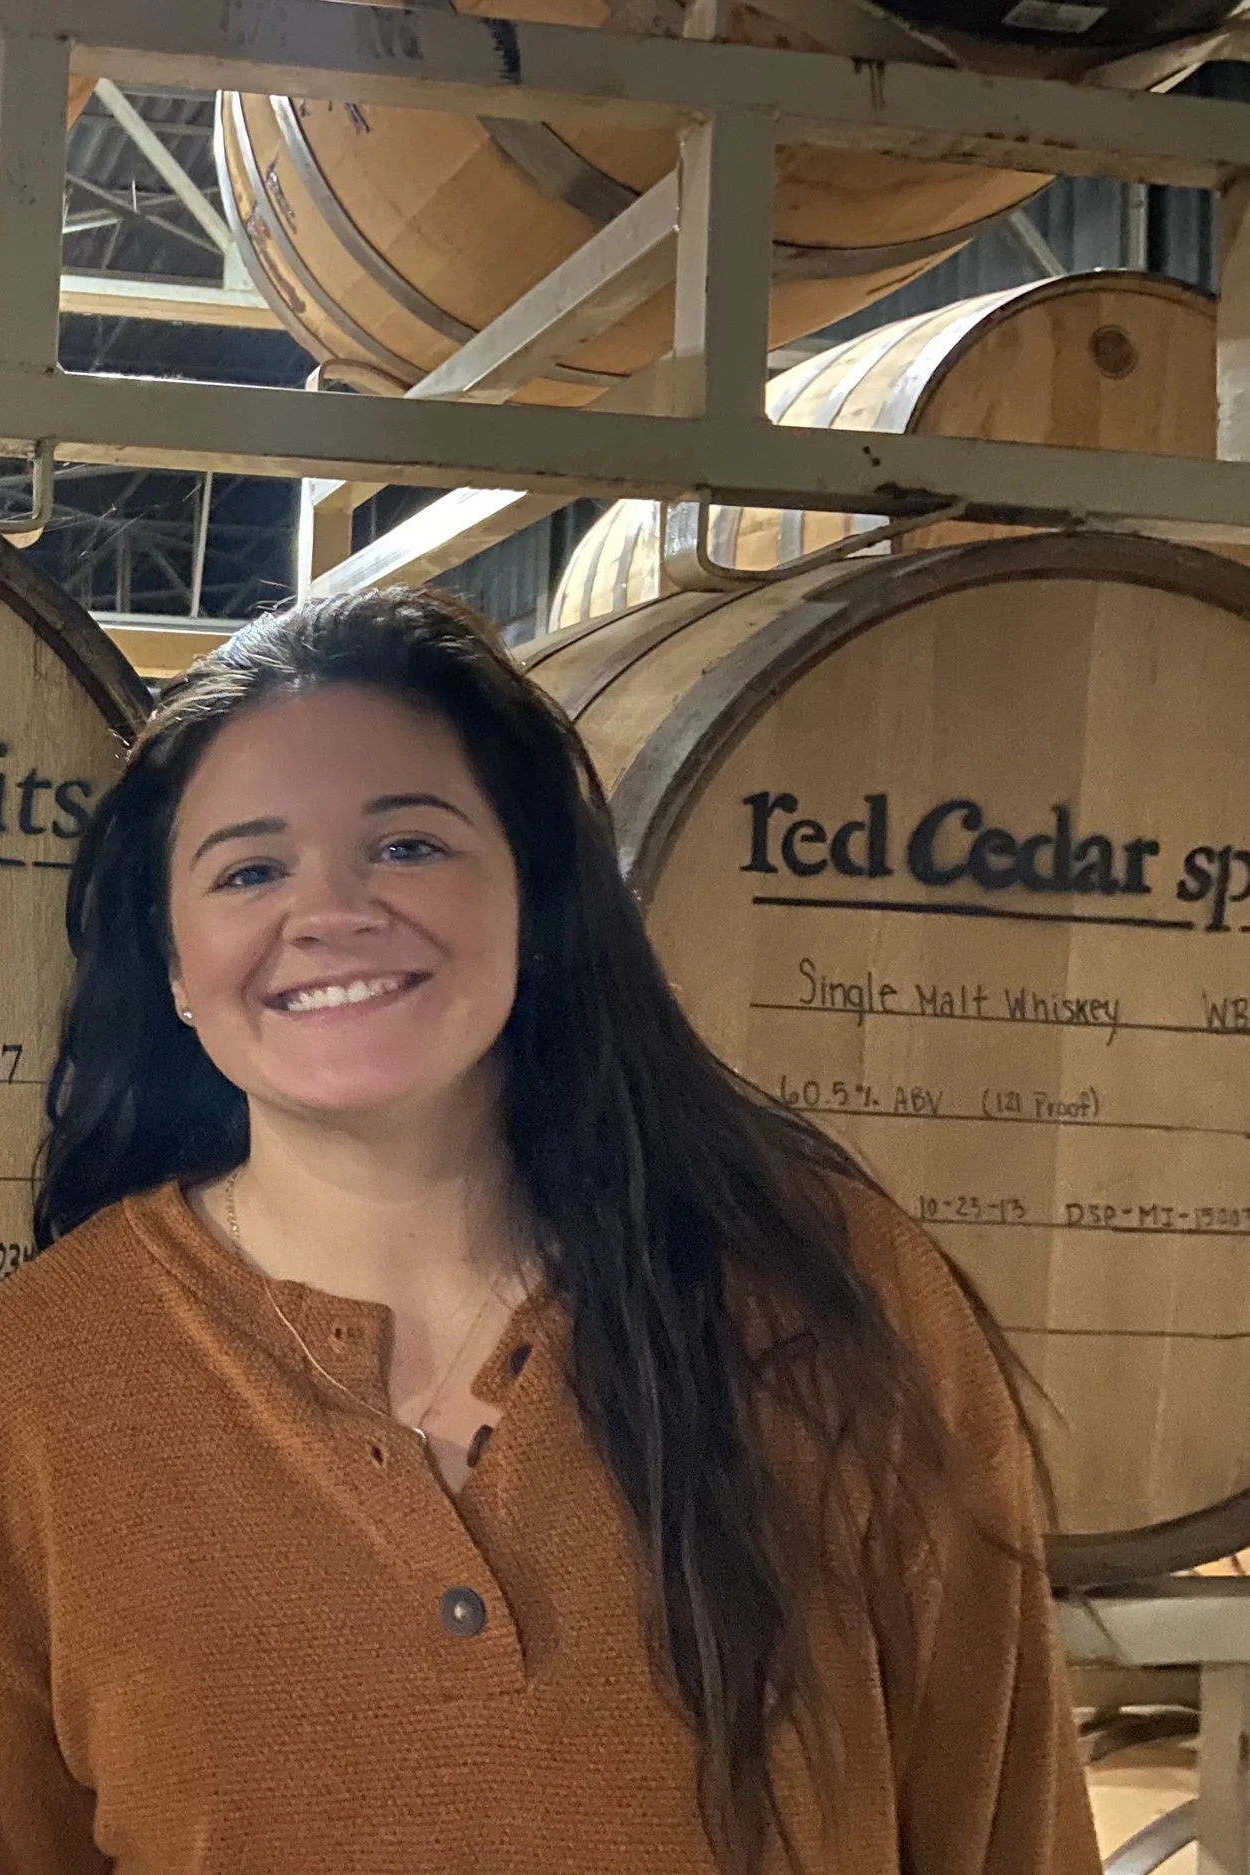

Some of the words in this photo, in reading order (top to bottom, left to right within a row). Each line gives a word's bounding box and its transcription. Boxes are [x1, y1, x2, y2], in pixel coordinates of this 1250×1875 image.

[739, 791, 893, 878] red
[906, 799, 1160, 895] Cedar
[798, 958, 898, 1027] Single
[915, 983, 984, 1019] Malt
[1004, 987, 1120, 1046] Whiskey
[893, 1086, 945, 1115] ABV
[1033, 1086, 1100, 1120] Proof)
